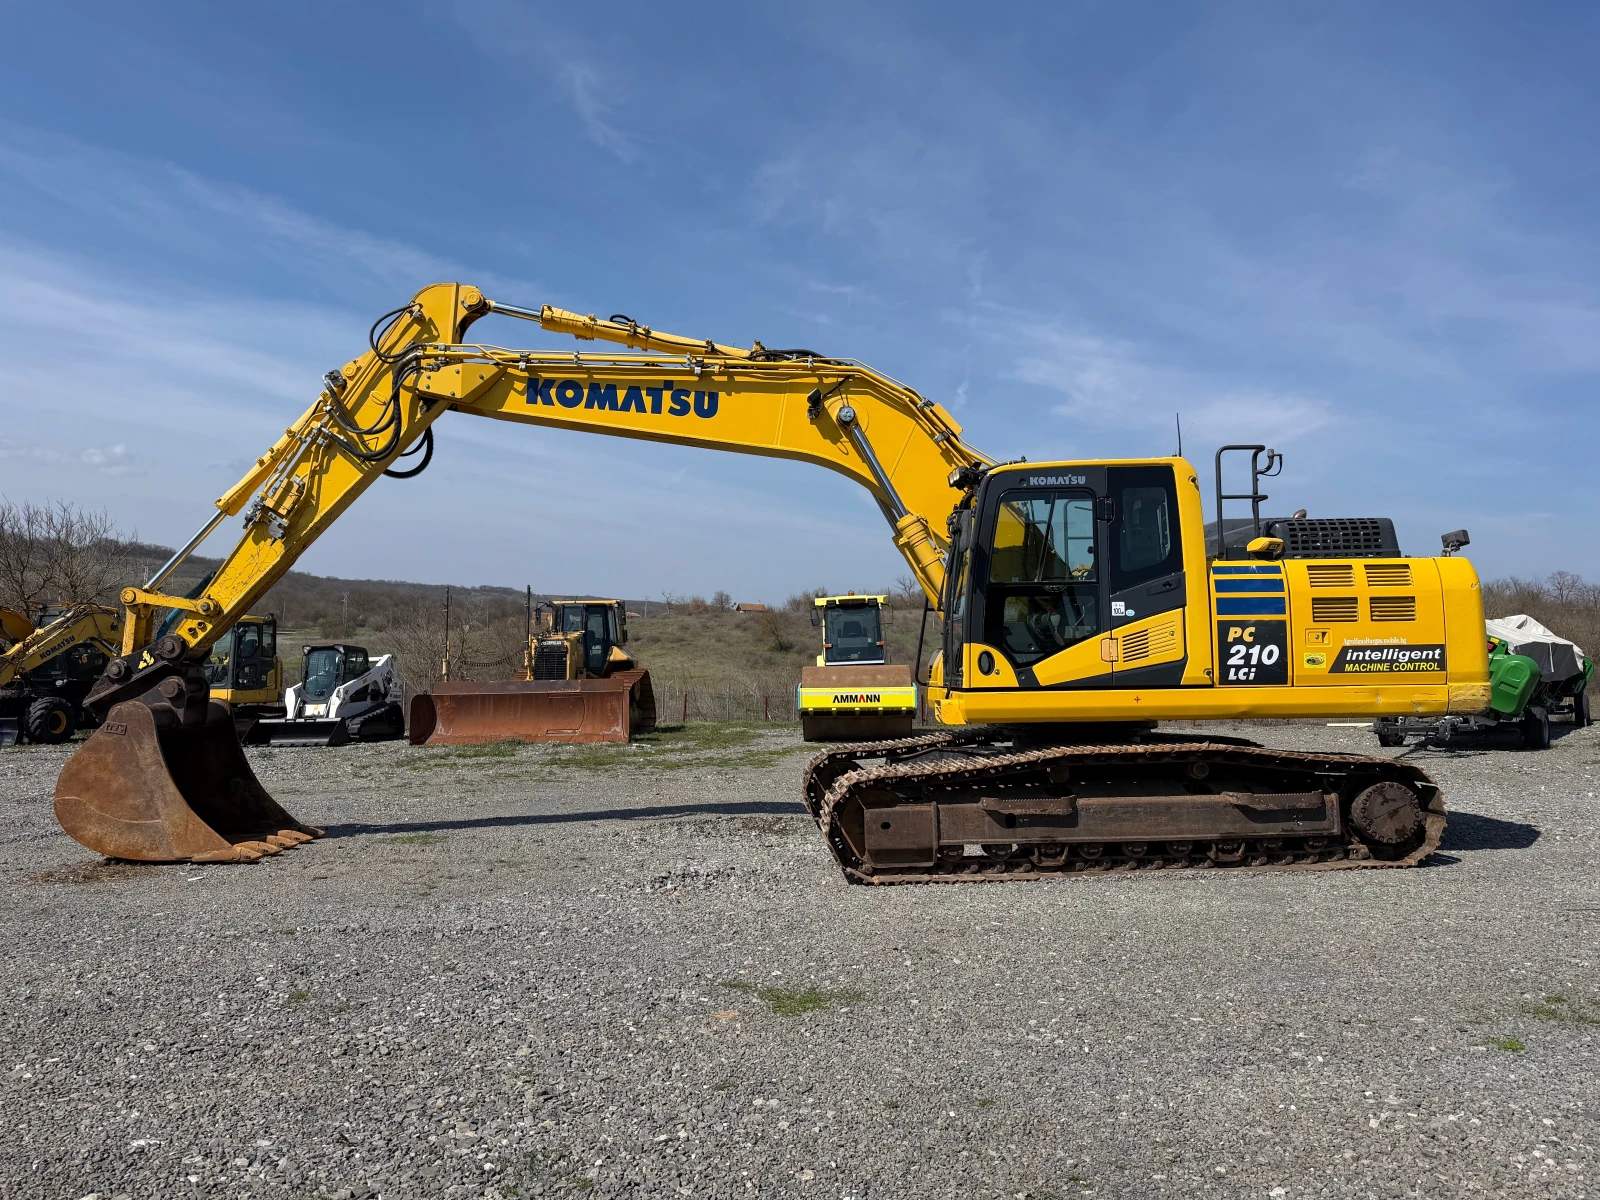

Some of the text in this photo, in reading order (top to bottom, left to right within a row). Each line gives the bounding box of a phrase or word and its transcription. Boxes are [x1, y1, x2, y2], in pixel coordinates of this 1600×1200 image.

[526, 377, 720, 419] KOMATSU
[1029, 474, 1086, 486] KOMATSU
[1227, 626, 1256, 643] PC
[40, 635, 76, 660] KOMATSU
[1226, 644, 1280, 666] 210
[1346, 648, 1442, 663] intelligent
[1227, 667, 1257, 681] LCi
[1344, 662, 1441, 672] MACHINE CONTROL
[832, 693, 881, 704] AMMANN
